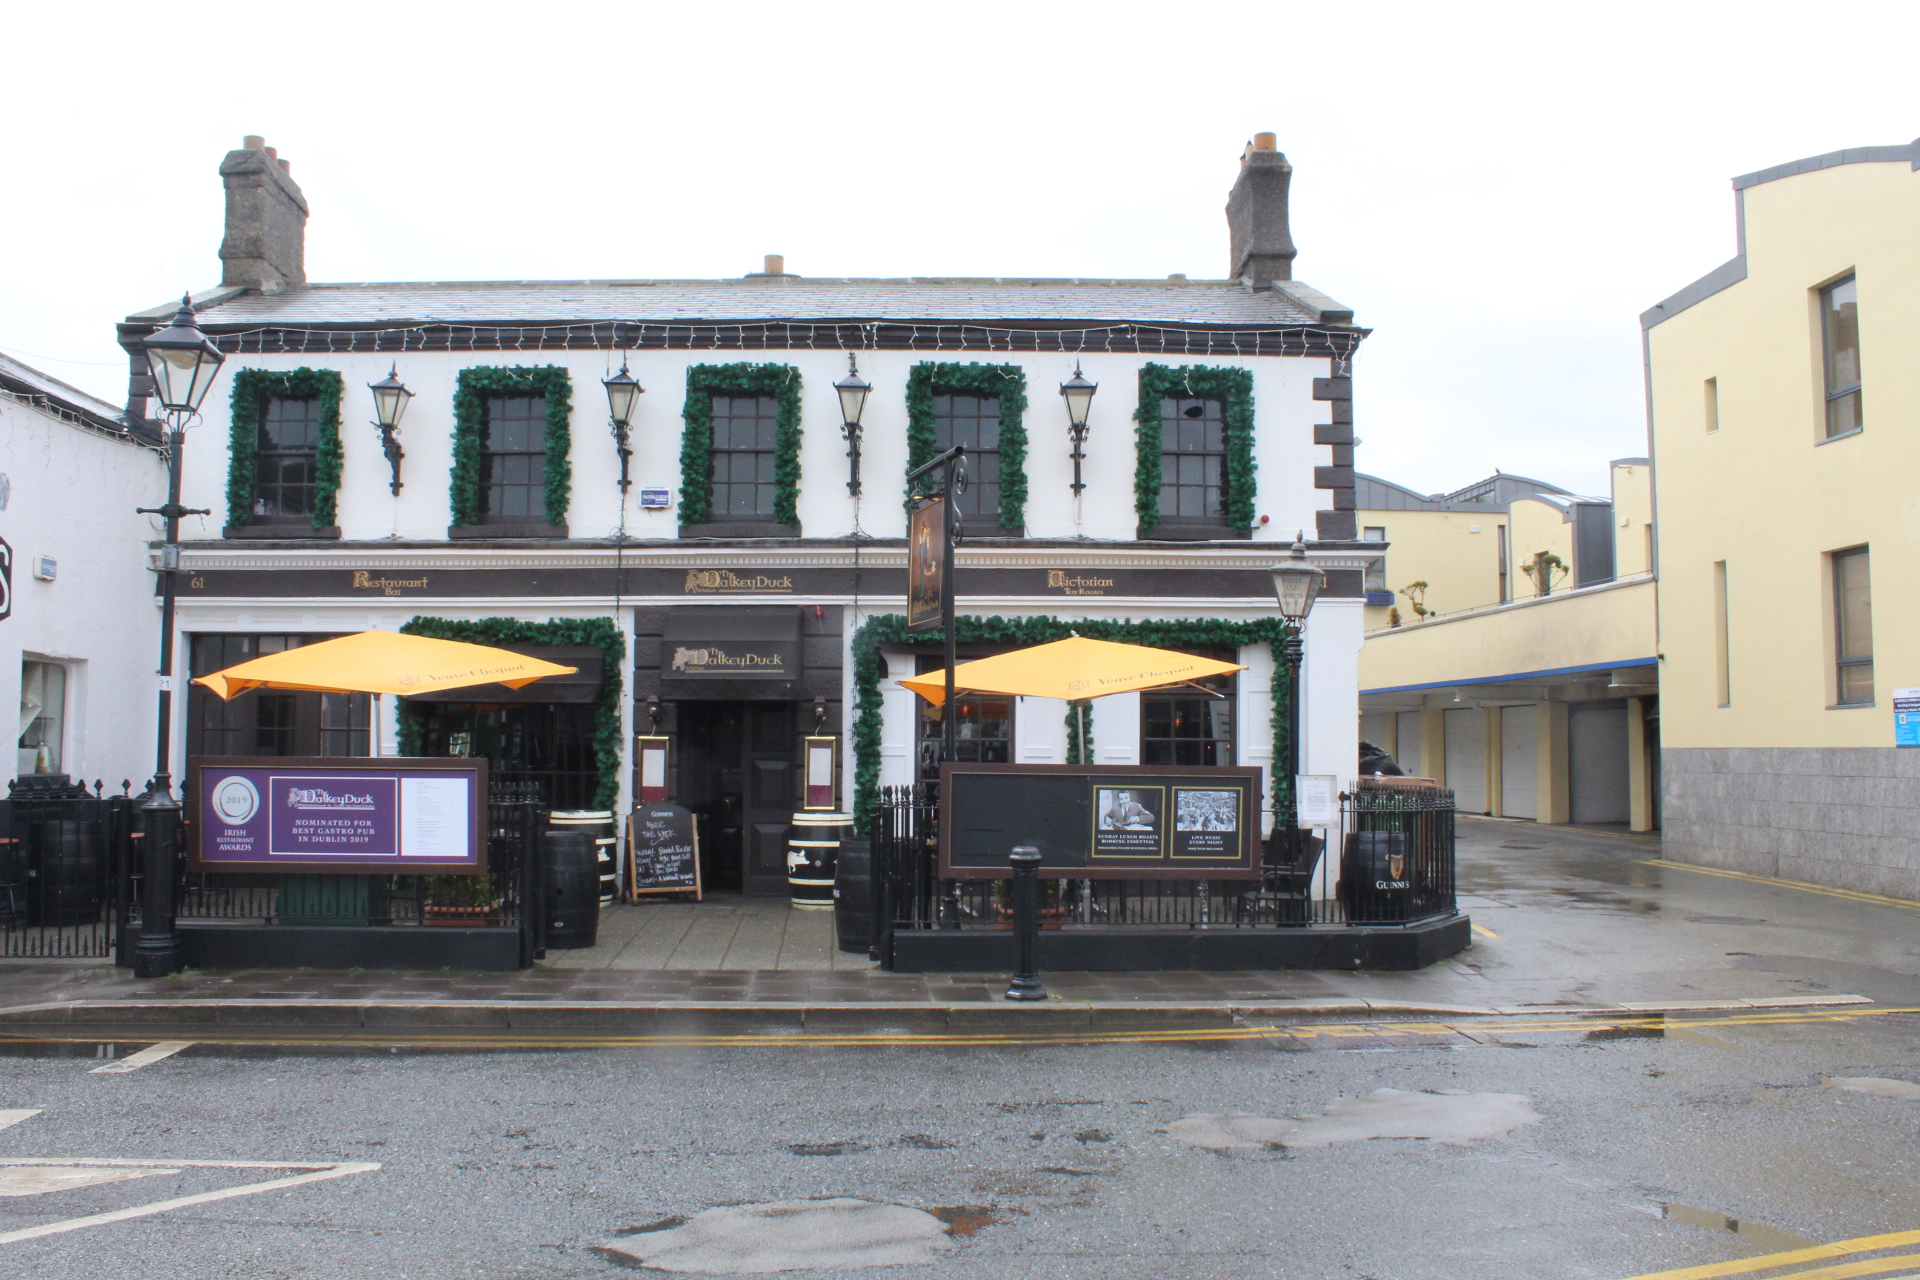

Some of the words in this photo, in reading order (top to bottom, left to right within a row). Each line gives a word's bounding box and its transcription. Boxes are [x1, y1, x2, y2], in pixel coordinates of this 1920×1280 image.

[191, 577, 205, 589] 61
[352, 570, 429, 588] Restaurant
[385, 588, 401, 596] Bar
[428, 673, 467, 681] Veuve
[469, 664, 525, 676] Clicquot
[1098, 675, 1136, 685] Veuve
[1139, 666, 1195, 678] Clicquot
[160, 679, 170, 688] 21
[226, 796, 248, 804] 2019
